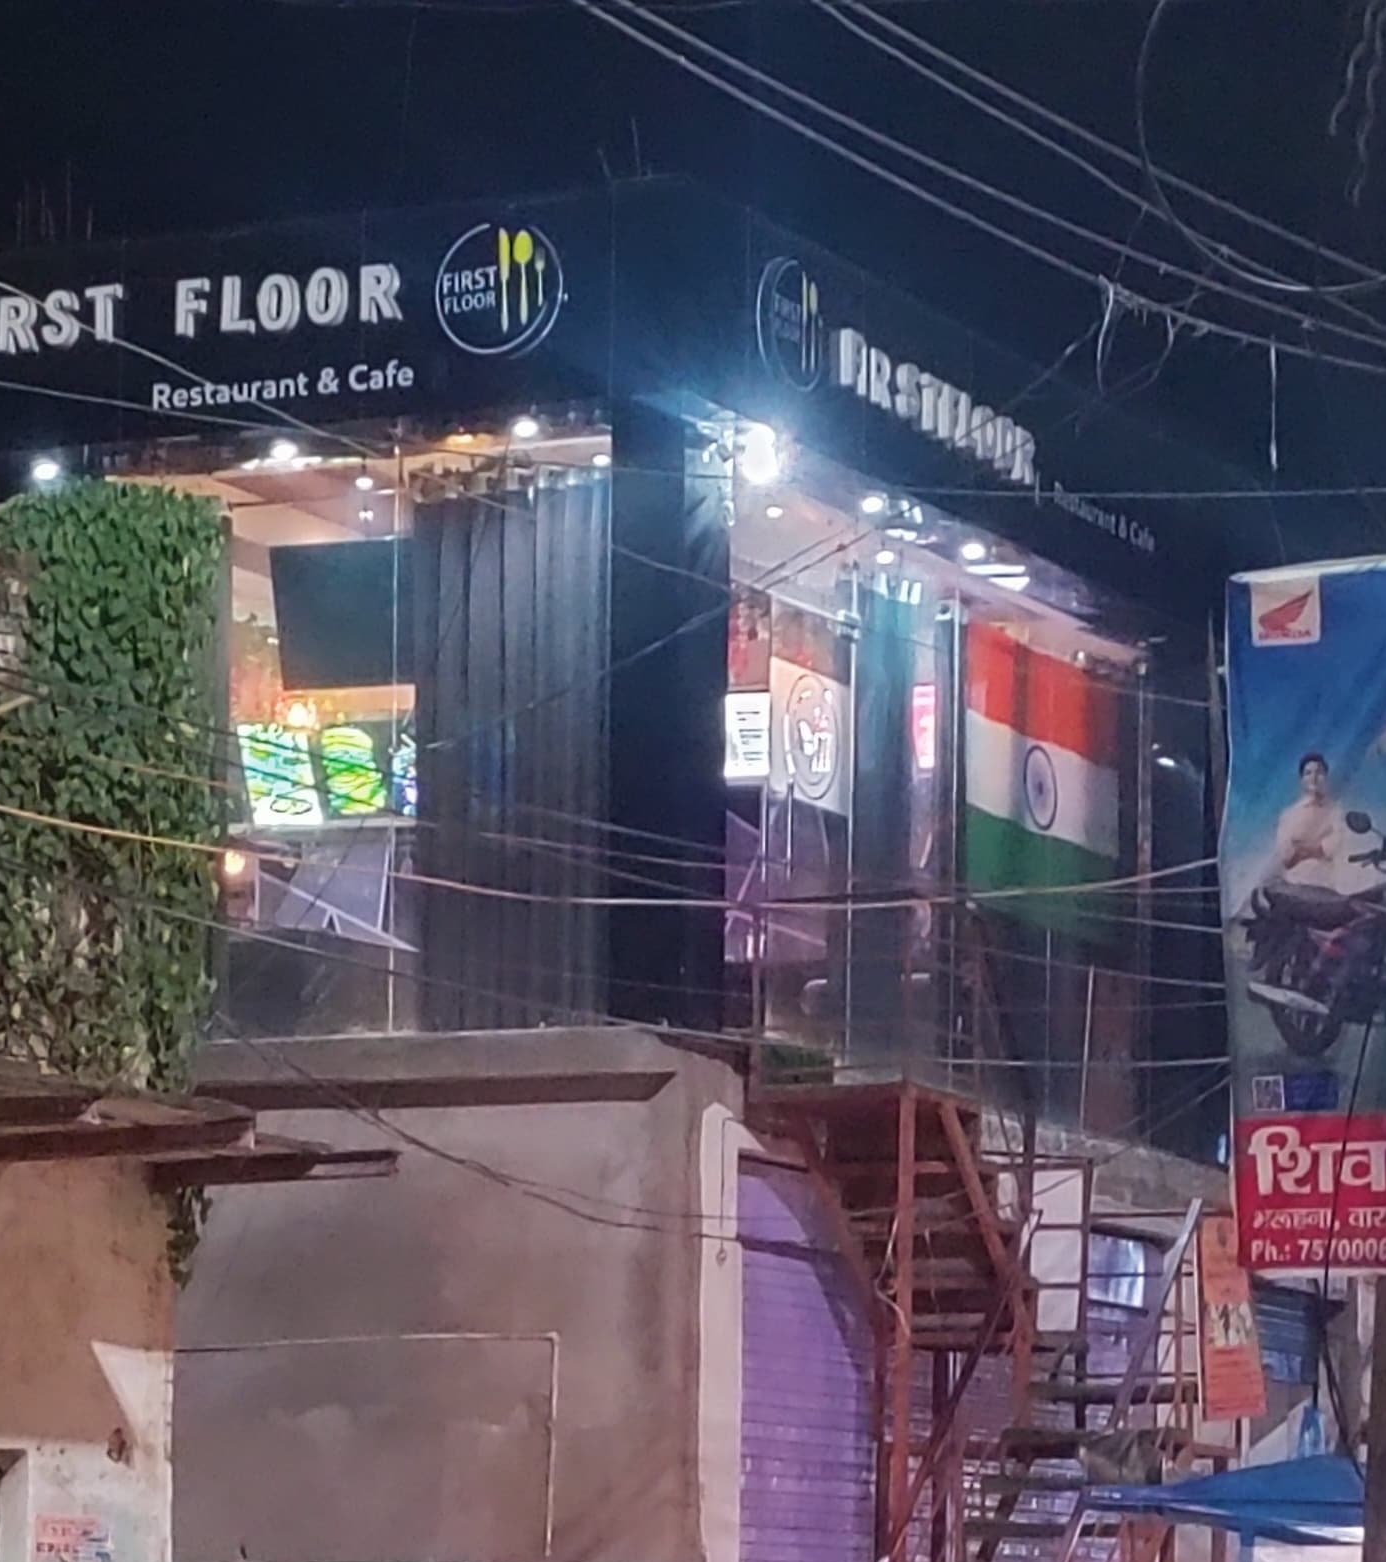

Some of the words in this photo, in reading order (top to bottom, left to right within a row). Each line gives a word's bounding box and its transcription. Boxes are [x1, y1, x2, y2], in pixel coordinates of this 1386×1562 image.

[442, 265, 497, 295] FIRST
[174, 263, 404, 338] FLOOR
[443, 290, 496, 315] FLOOR
[152, 373, 308, 410] Restaurant
[317, 367, 339, 394] &
[348, 360, 415, 391] Cafe
